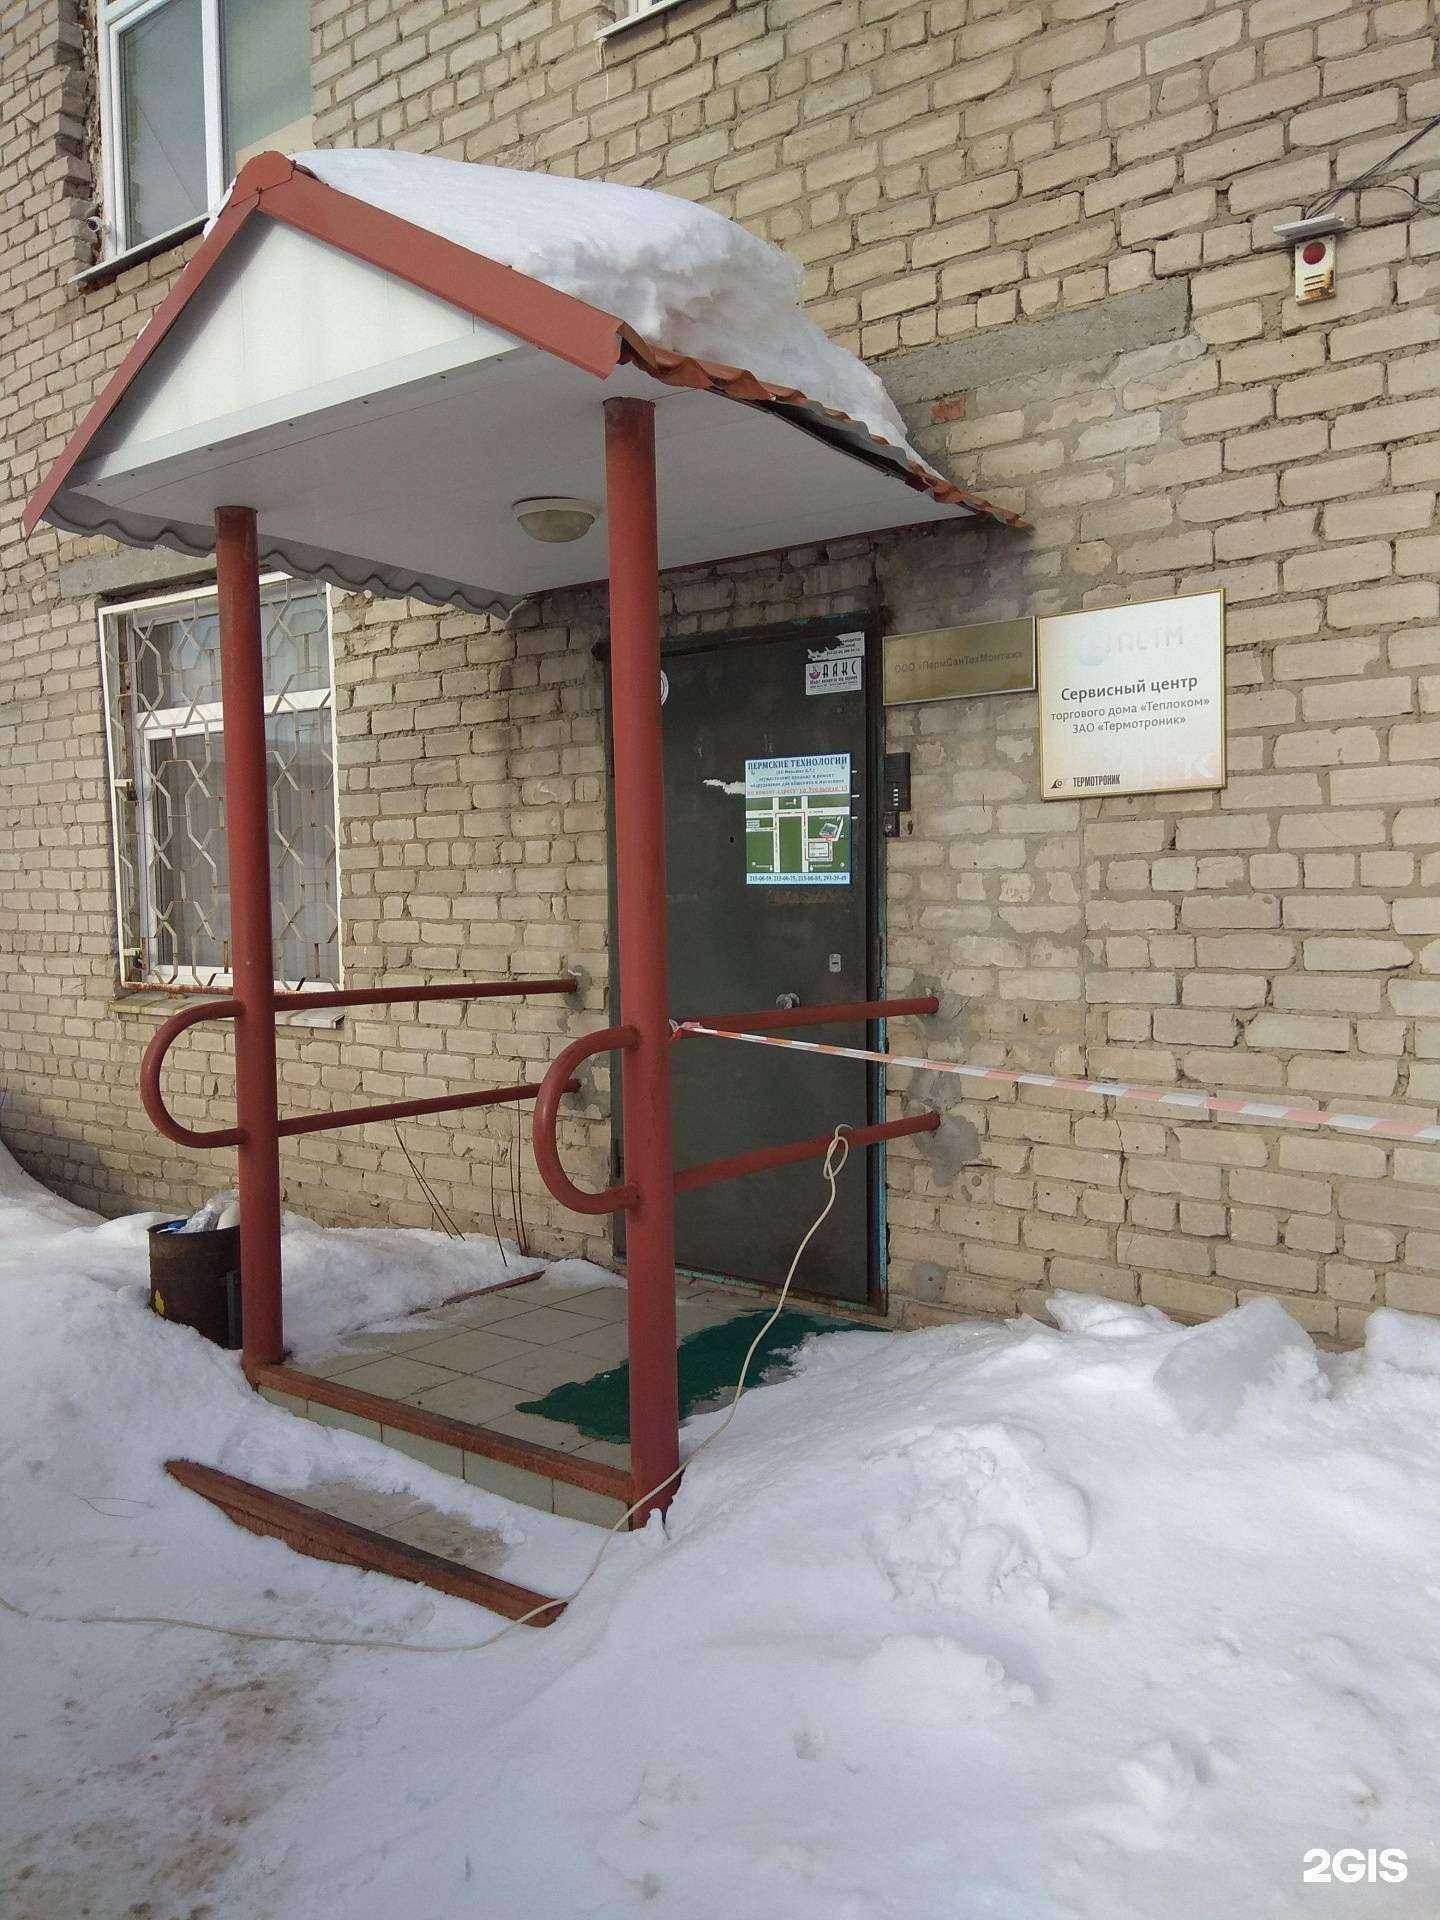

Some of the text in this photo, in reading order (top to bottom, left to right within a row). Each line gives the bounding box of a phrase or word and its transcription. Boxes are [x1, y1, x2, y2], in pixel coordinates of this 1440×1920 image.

[894, 662, 914, 673] ООО
[1061, 676, 1198, 703] Сервисный центр
[1050, 698, 1210, 723] торгового дома «Теплоком»
[1073, 717, 1187, 734] ЗАО «Термотроник»
[747, 756, 848, 770] ПЕРМСКИЕ ТЕХНОЛОГИИ
[1072, 774, 1121, 788] ТЕРМОТРОНИК
